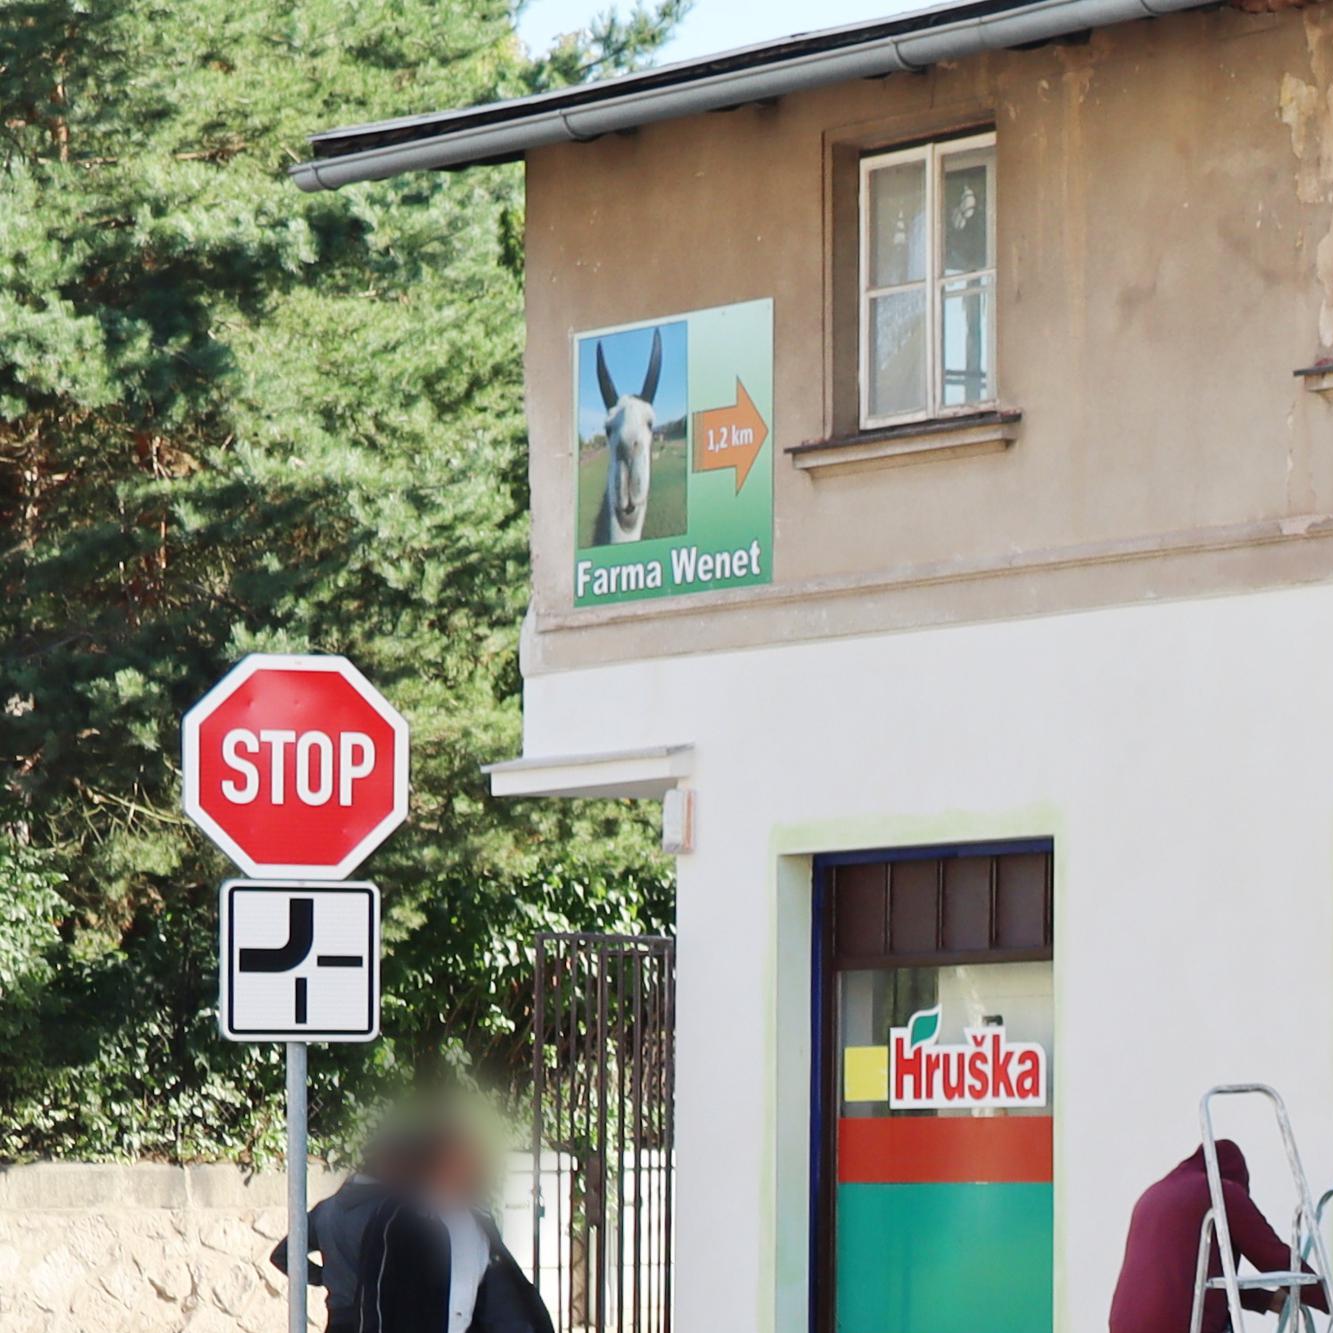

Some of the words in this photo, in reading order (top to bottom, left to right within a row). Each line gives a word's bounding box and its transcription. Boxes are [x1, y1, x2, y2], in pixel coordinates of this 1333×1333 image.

[707, 426, 728, 451] 1,2
[731, 425, 754, 447] km
[576, 560, 662, 598] Farma
[671, 539, 761, 585] Wenet
[221, 727, 376, 807] STOP
[894, 1033, 1041, 1101] Hruška
